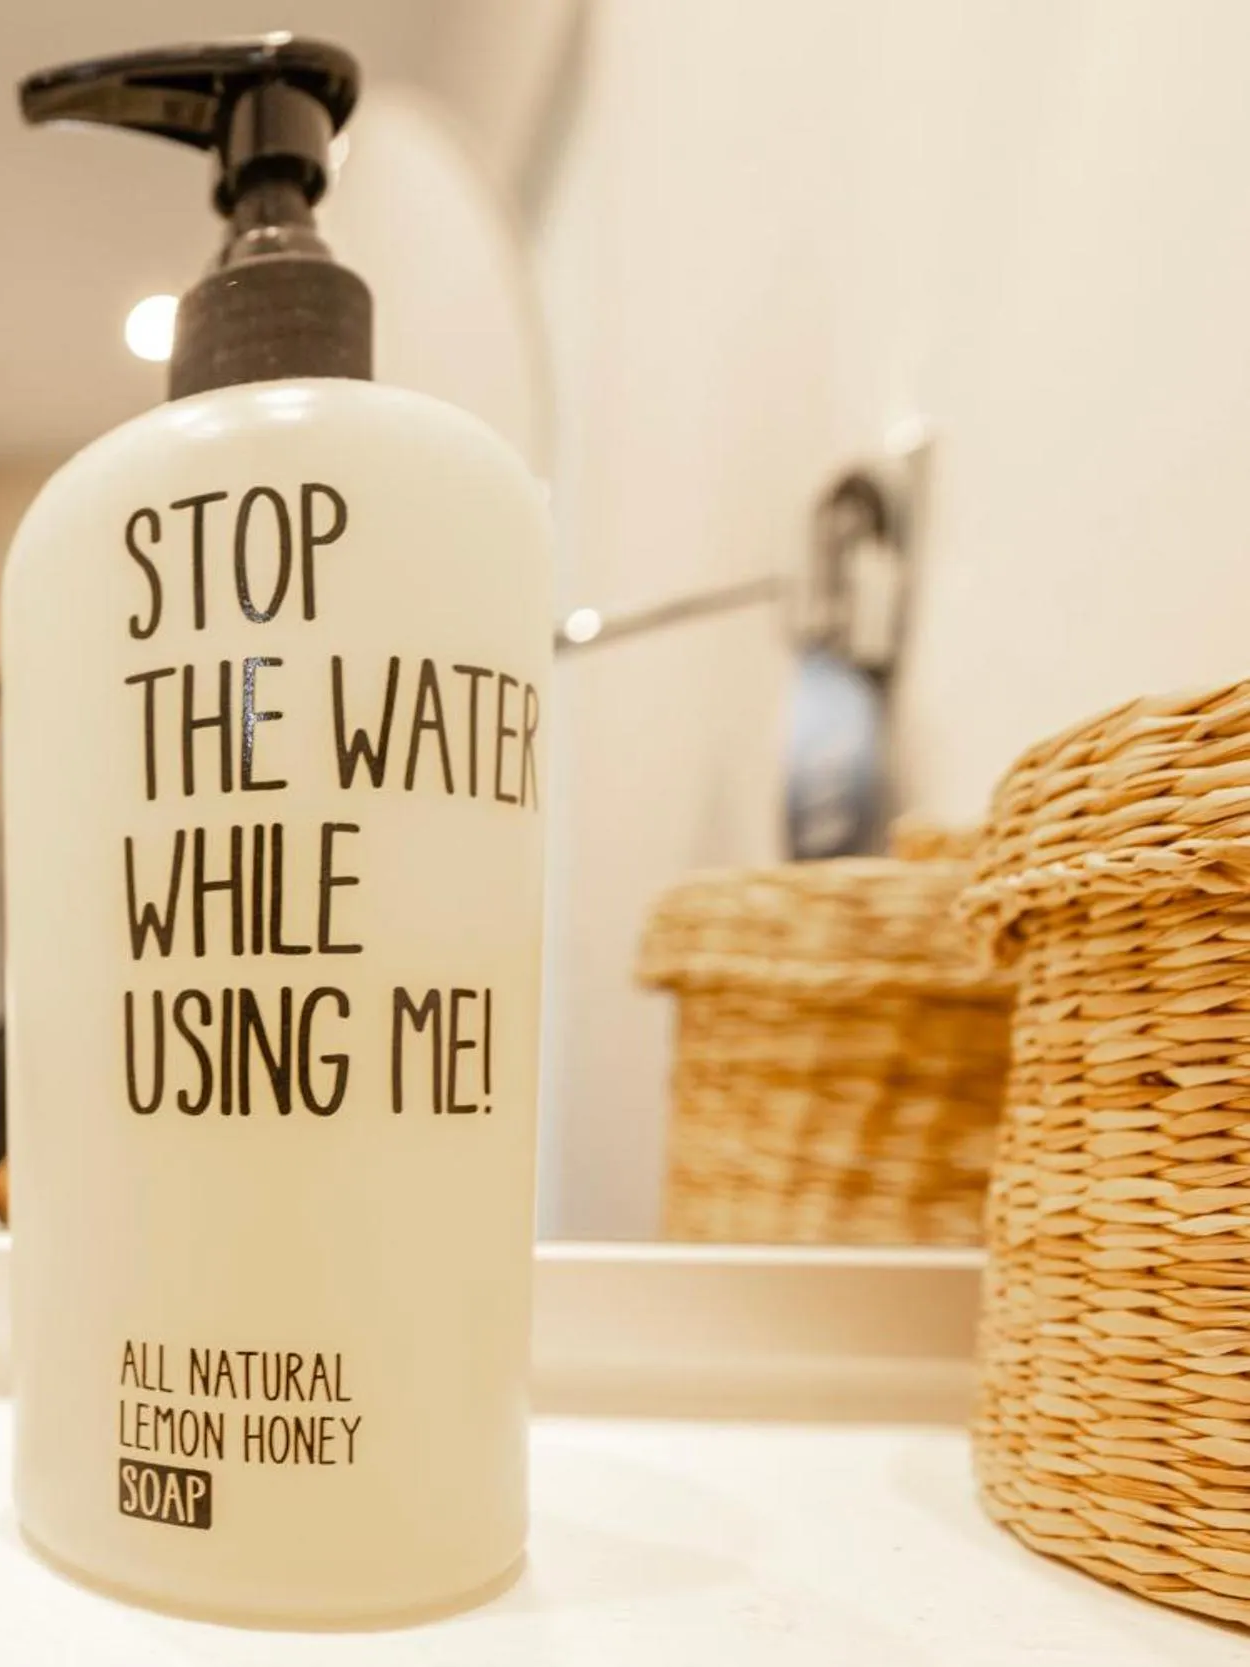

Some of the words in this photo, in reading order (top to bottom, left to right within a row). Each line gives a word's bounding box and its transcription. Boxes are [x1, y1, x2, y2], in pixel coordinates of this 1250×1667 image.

[124, 481, 348, 641] STOP
[124, 656, 288, 801] THE
[331, 655, 540, 812] WATER
[124, 821, 364, 961] WHILE
[123, 986, 352, 1117] USING
[391, 986, 494, 1115] ME!
[119, 1399, 225, 1461] LEMON
[243, 1414, 363, 1465] HONEY
[120, 1339, 175, 1394] ALL
[189, 1346, 353, 1403] NATURAL
[121, 1464, 207, 1525] SOAP
